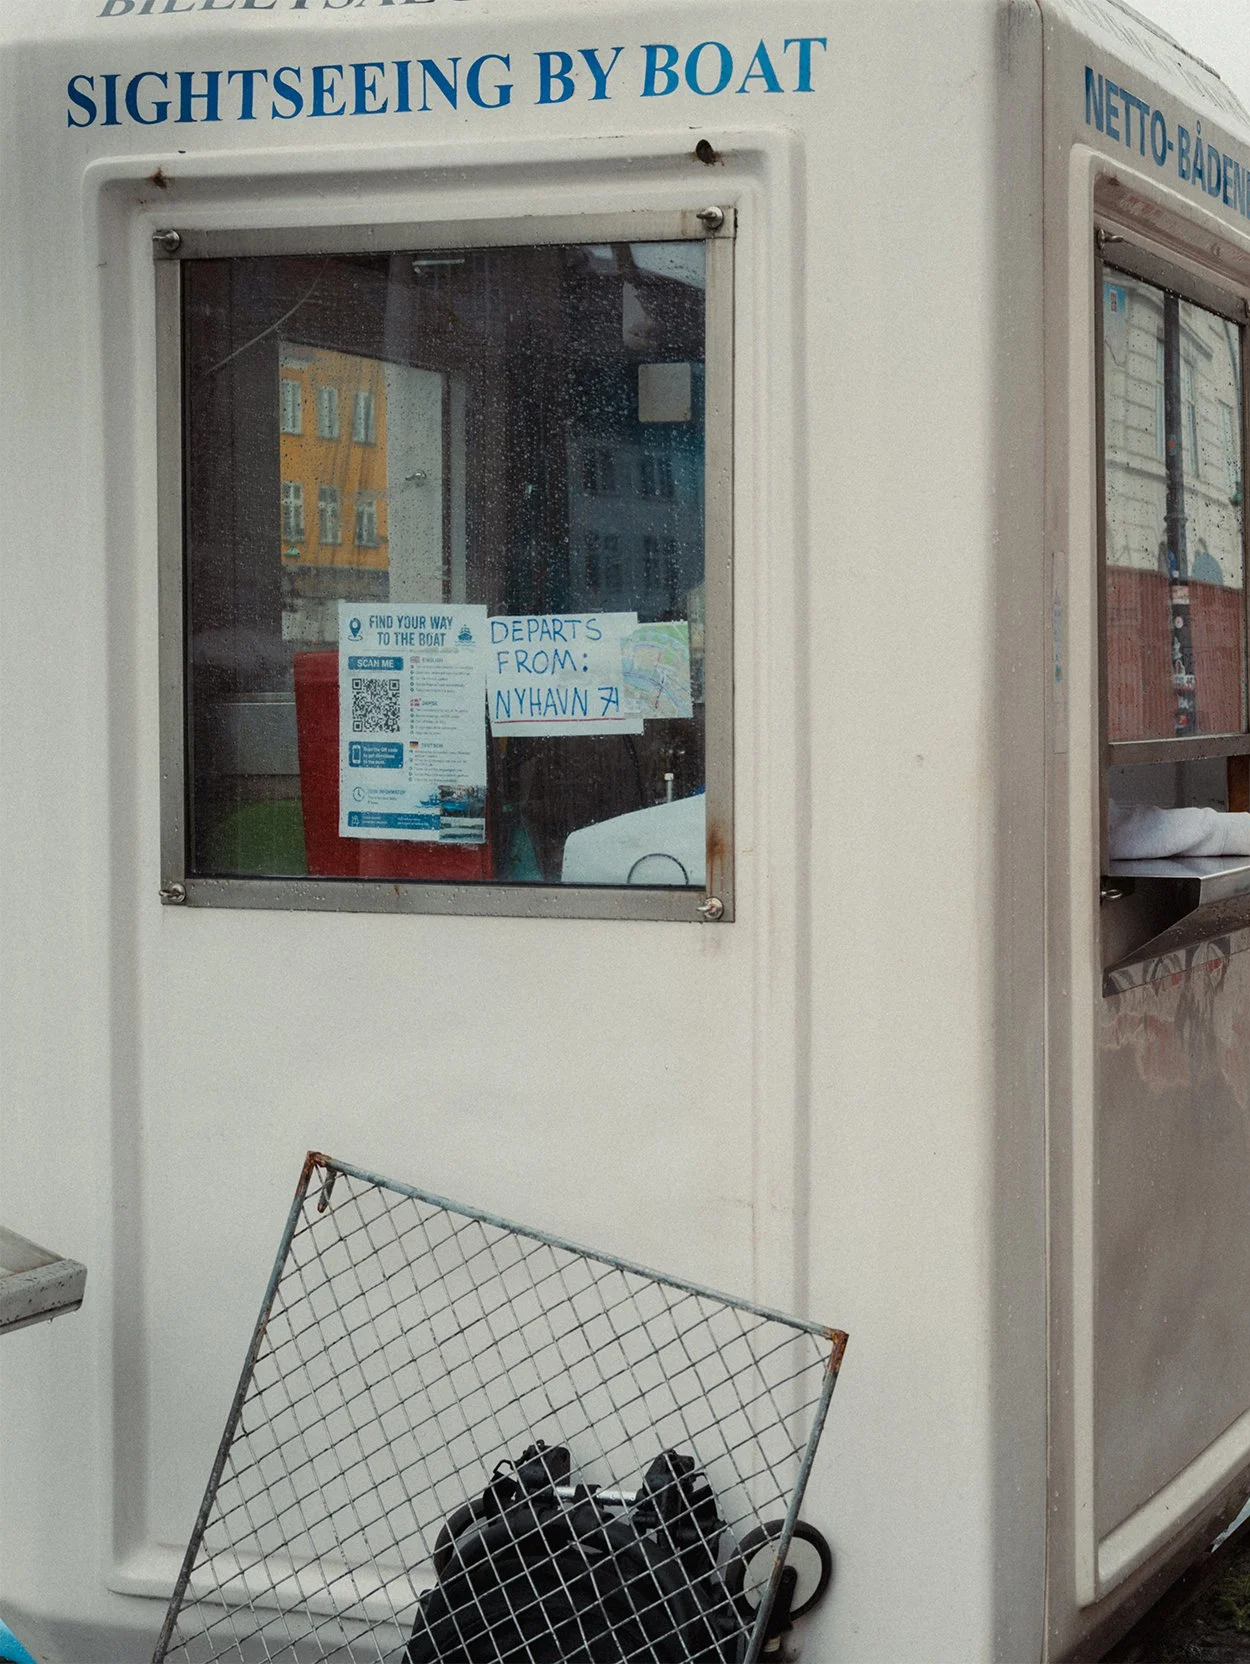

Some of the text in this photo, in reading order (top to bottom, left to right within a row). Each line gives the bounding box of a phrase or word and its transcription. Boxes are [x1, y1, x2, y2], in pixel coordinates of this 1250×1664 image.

[67, 36, 828, 128] SIGHTSEEING BY BOAT
[369, 615, 454, 630] FIND YOUR WAY
[490, 617, 602, 644] DEPARTS
[377, 631, 446, 647] TO THE BOAT
[357, 659, 394, 669] SCAN ME
[497, 649, 589, 675] FROM:
[495, 687, 589, 720] NYHAVN
